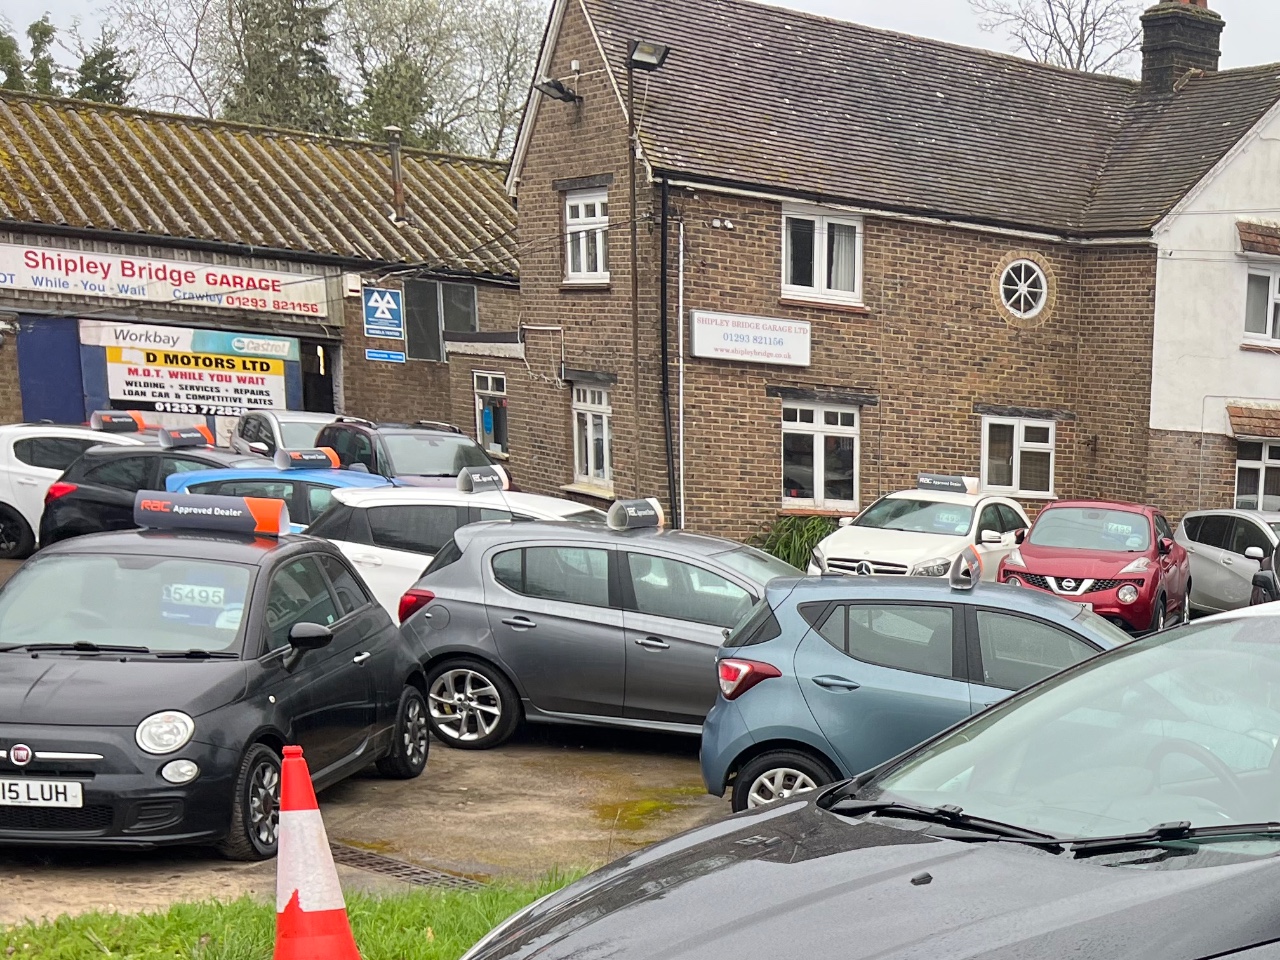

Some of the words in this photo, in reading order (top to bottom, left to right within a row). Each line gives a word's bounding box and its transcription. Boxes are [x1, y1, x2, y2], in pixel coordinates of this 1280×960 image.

[24, 250, 112, 280] Shipley
[121, 260, 196, 287] Bridge
[205, 272, 282, 293] GARAGE
[31, 275, 70, 289] While
[80, 279, 106, 293] You
[117, 283, 147, 297] Wait
[172, 288, 223, 305] Crawley
[226, 295, 267, 309] 01293
[272, 300, 319, 313] 821156
[696, 317, 730, 327] SHIPLEY
[731, 320, 760, 330] BRIDGE
[762, 323, 793, 334] GARAGE
[793, 326, 808, 335] LTD
[113, 328, 180, 347] Workbay
[246, 339, 286, 354] Castrol
[723, 332, 750, 343] 01293
[752, 335, 784, 346] 821156
[713, 346, 792, 359] www.shipleybridge.co.uk
[146, 352, 158, 363] D
[163, 353, 236, 370] MOTORS
[241, 359, 271, 372] LTD
[127, 367, 164, 379] M.O.T.
[168, 370, 204, 381] WHILE
[208, 373, 232, 383] YOU
[236, 375, 267, 386] WAIT
[123, 389, 147, 397] LOAN
[151, 391, 170, 399] CAR
[185, 393, 243, 404] COMPETITIVE
[247, 397, 274, 406] RATES
[125, 380, 165, 389] WELDING
[178, 383, 221, 393] SERVICES
[233, 388, 271, 397] REPAIRS
[155, 402, 197, 413] 01293
[140, 499, 172, 512] RAC
[172, 504, 212, 515] Approved
[214, 506, 243, 517] Dealer
[26, 783, 68, 802] LUH
